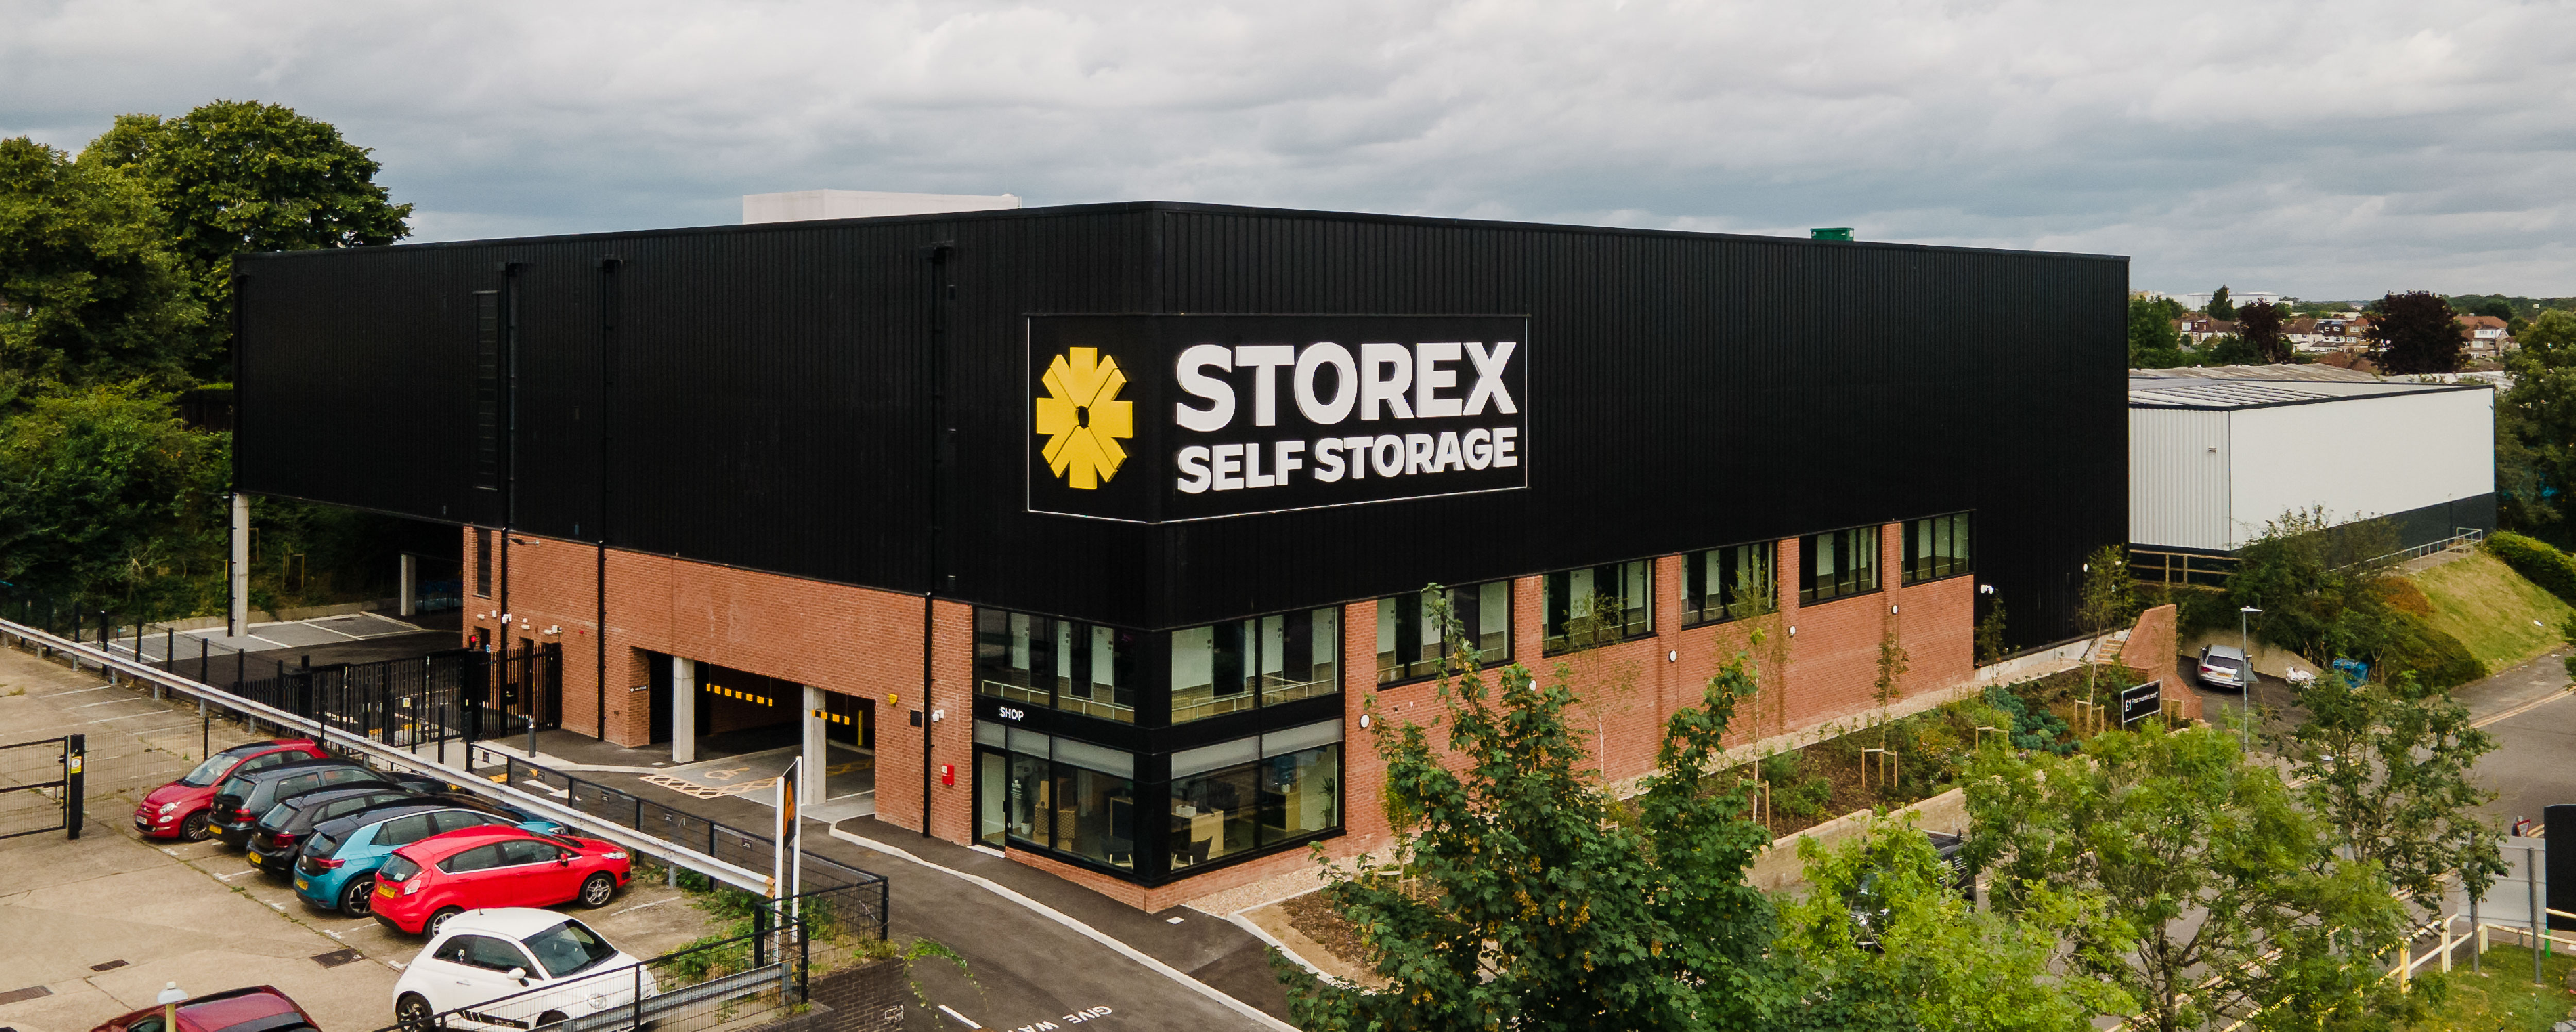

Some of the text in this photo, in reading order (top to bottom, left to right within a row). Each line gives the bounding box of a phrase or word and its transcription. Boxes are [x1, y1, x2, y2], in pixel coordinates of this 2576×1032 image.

[1176, 342, 1518, 432] STOREX
[1176, 427, 1518, 494] SELF STORAGE
[999, 706, 1024, 721] SHOP
[1008, 1006, 1112, 1032] GIVE WA
